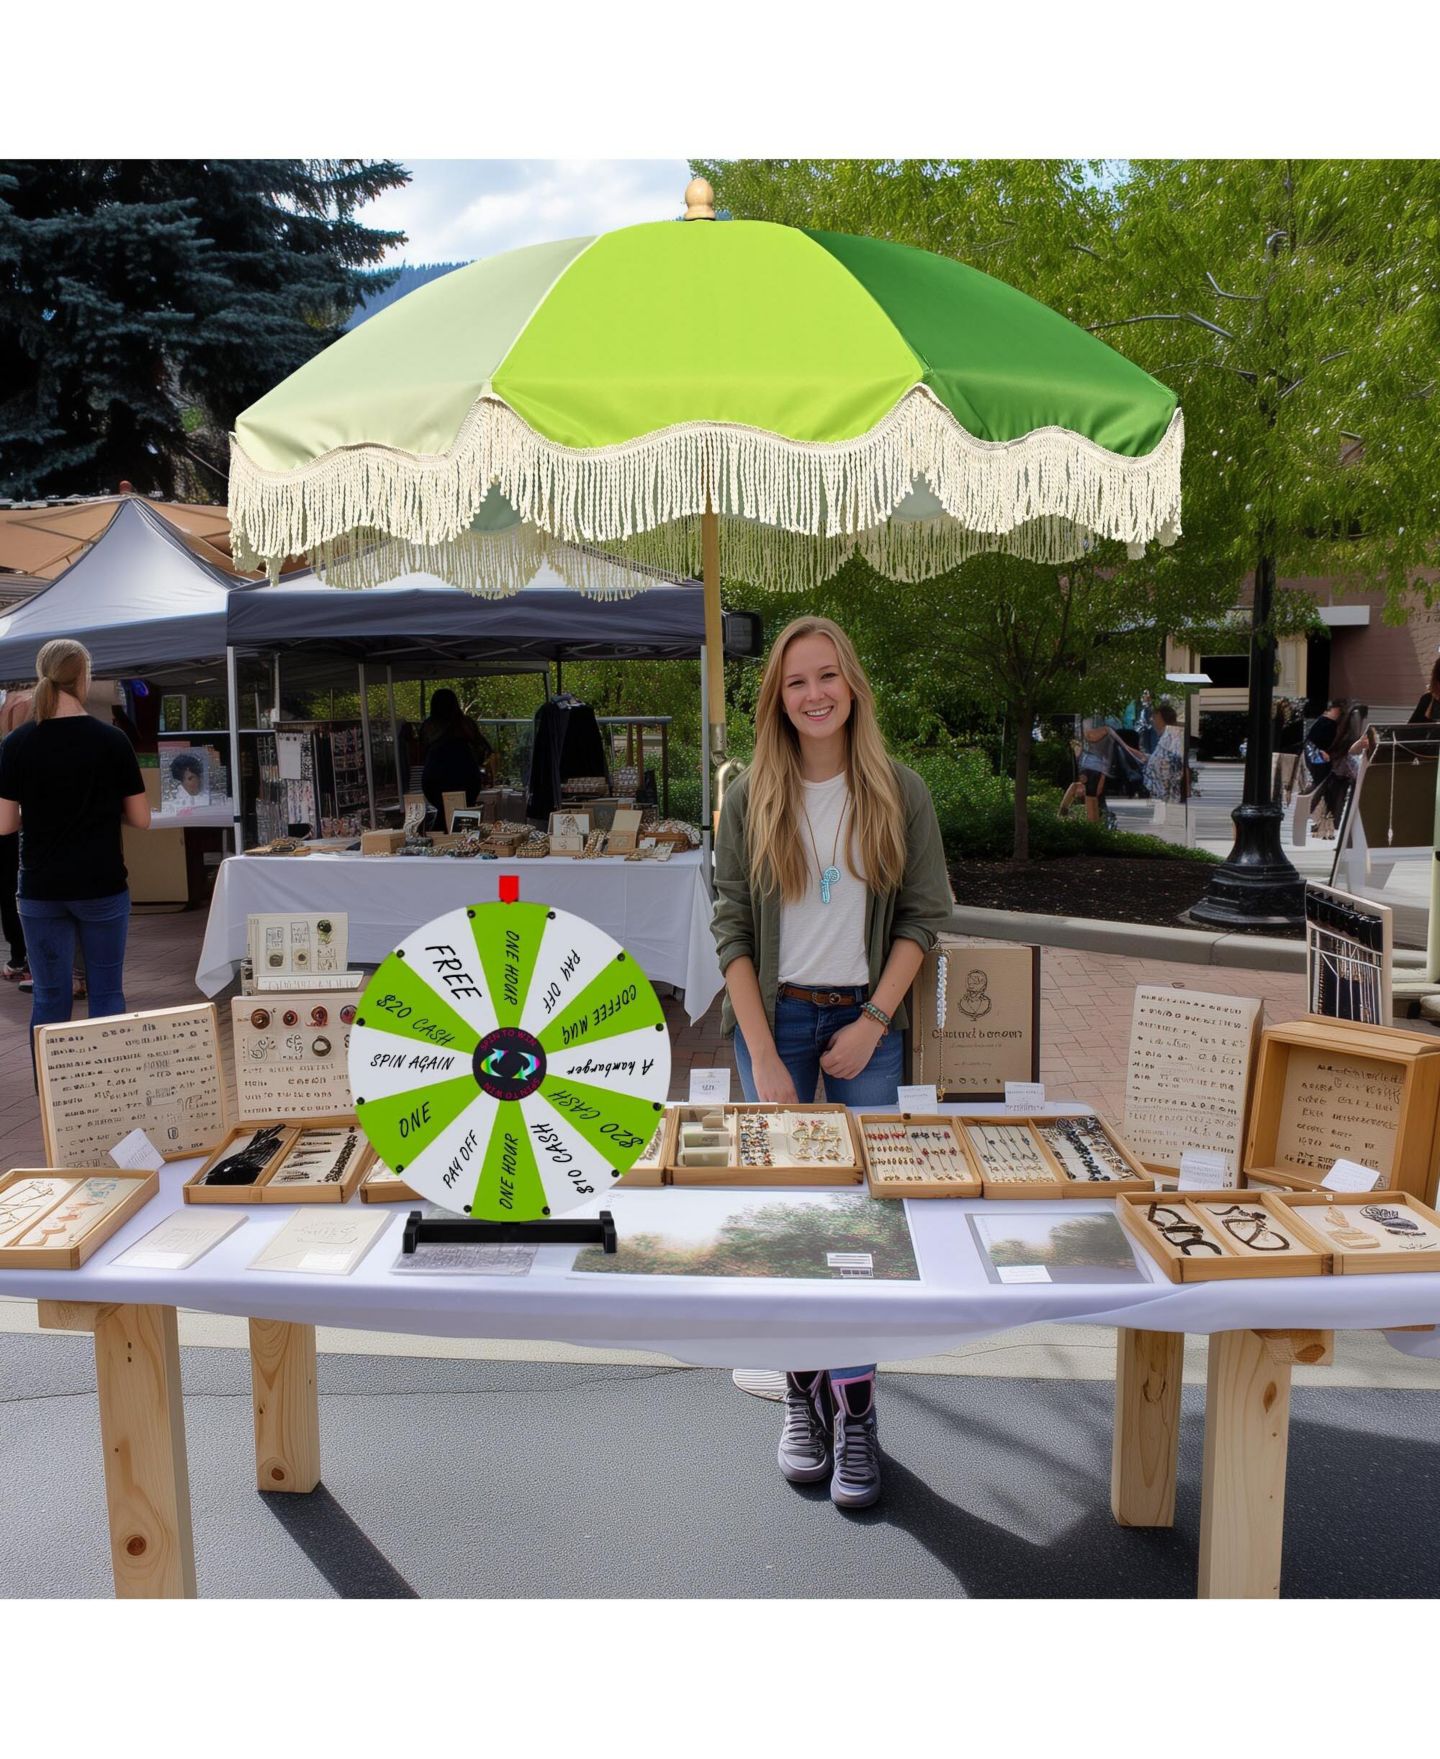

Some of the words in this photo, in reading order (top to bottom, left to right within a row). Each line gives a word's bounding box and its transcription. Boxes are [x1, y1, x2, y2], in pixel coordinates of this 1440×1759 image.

[506, 931, 519, 962] ONE
[425, 945, 482, 999] FREE
[561, 950, 580, 981] PAY
[504, 964, 518, 1005] HOUR
[543, 983, 561, 1014] OFF
[377, 995, 411, 1018] $20
[413, 1019, 454, 1045] CASH
[593, 985, 636, 1025] COFFEE
[480, 1033, 499, 1049] SPIN
[517, 1031, 537, 1045] WIN
[562, 1016, 587, 1044] MUG
[371, 1054, 404, 1067] SPIN
[409, 1056, 454, 1072] AGAIN
[567, 1059, 635, 1077] hamburger
[642, 1059, 653, 1075] A
[484, 1082, 503, 1097] WIN
[520, 1079, 540, 1095] SPIN
[400, 1102, 430, 1137] ONE
[549, 1091, 600, 1119] CASH
[531, 1124, 572, 1162] CASH
[600, 1124, 643, 1147] $20
[443, 1158, 462, 1188] PAY
[456, 1130, 477, 1163] OFF
[502, 1134, 518, 1175] HOUR
[500, 1177, 513, 1209] ONE
[568, 1170, 594, 1193] $10
